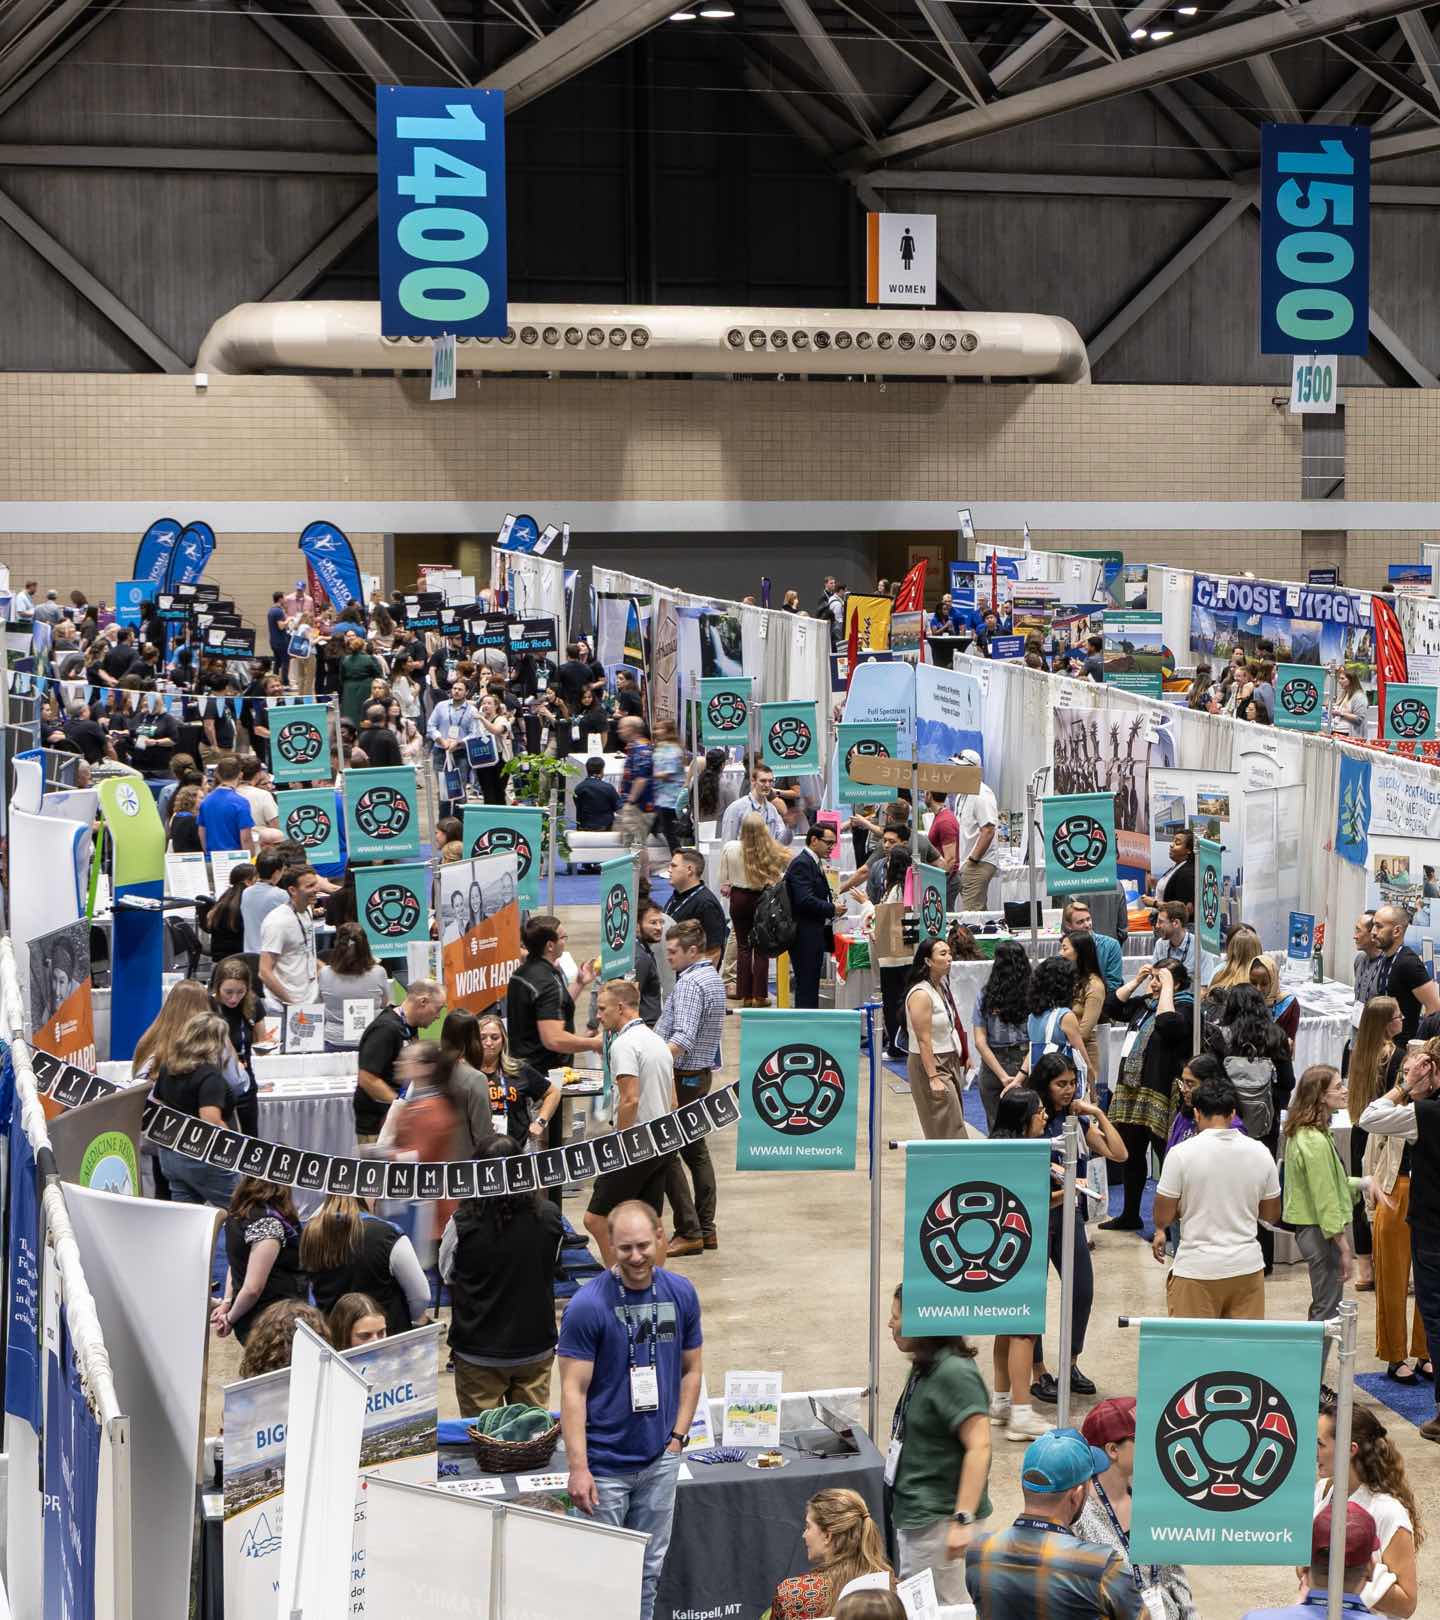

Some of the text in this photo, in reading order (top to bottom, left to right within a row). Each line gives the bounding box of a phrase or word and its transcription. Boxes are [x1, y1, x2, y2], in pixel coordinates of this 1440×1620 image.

[396, 104, 490, 322] 1400
[1276, 140, 1354, 340] 1500
[889, 283, 927, 295] WOMEN
[1296, 365, 1333, 402] 1500
[511, 639, 552, 651] Little Rock
[879, 708, 906, 716] Spectrum
[878, 765, 954, 784] ARTCLE.
[1053, 877, 1109, 888] WWAMI Network
[455, 966, 488, 998] WORK
[36, 1062, 51, 1078] Z
[70, 1075, 81, 1091] Y
[162, 1115, 176, 1131] V
[191, 1127, 202, 1141] U
[223, 1138, 236, 1154] T
[251, 1146, 263, 1163] S
[280, 1154, 290, 1170] R
[307, 1160, 320, 1177] Q
[338, 1164, 348, 1181] P
[395, 1169, 408, 1186] N
[425, 1170, 436, 1186] M
[456, 1168, 465, 1185] L
[485, 1166, 496, 1183] K
[516, 1162, 523, 1179] J
[547, 1157, 554, 1174] I
[575, 1150, 584, 1167] H
[602, 1143, 612, 1159] G
[633, 1133, 641, 1150] F
[662, 1123, 670, 1139] E
[687, 1112, 698, 1128] D
[715, 1098, 726, 1113] C
[750, 1144, 844, 1156] WWAMI Network
[918, 1303, 1031, 1318] WWAMI Network
[365, 1382, 419, 1414] RENCE.
[1151, 1526, 1293, 1543] WWAMI Network
[672, 1603, 742, 1620] Kalispell, MT
